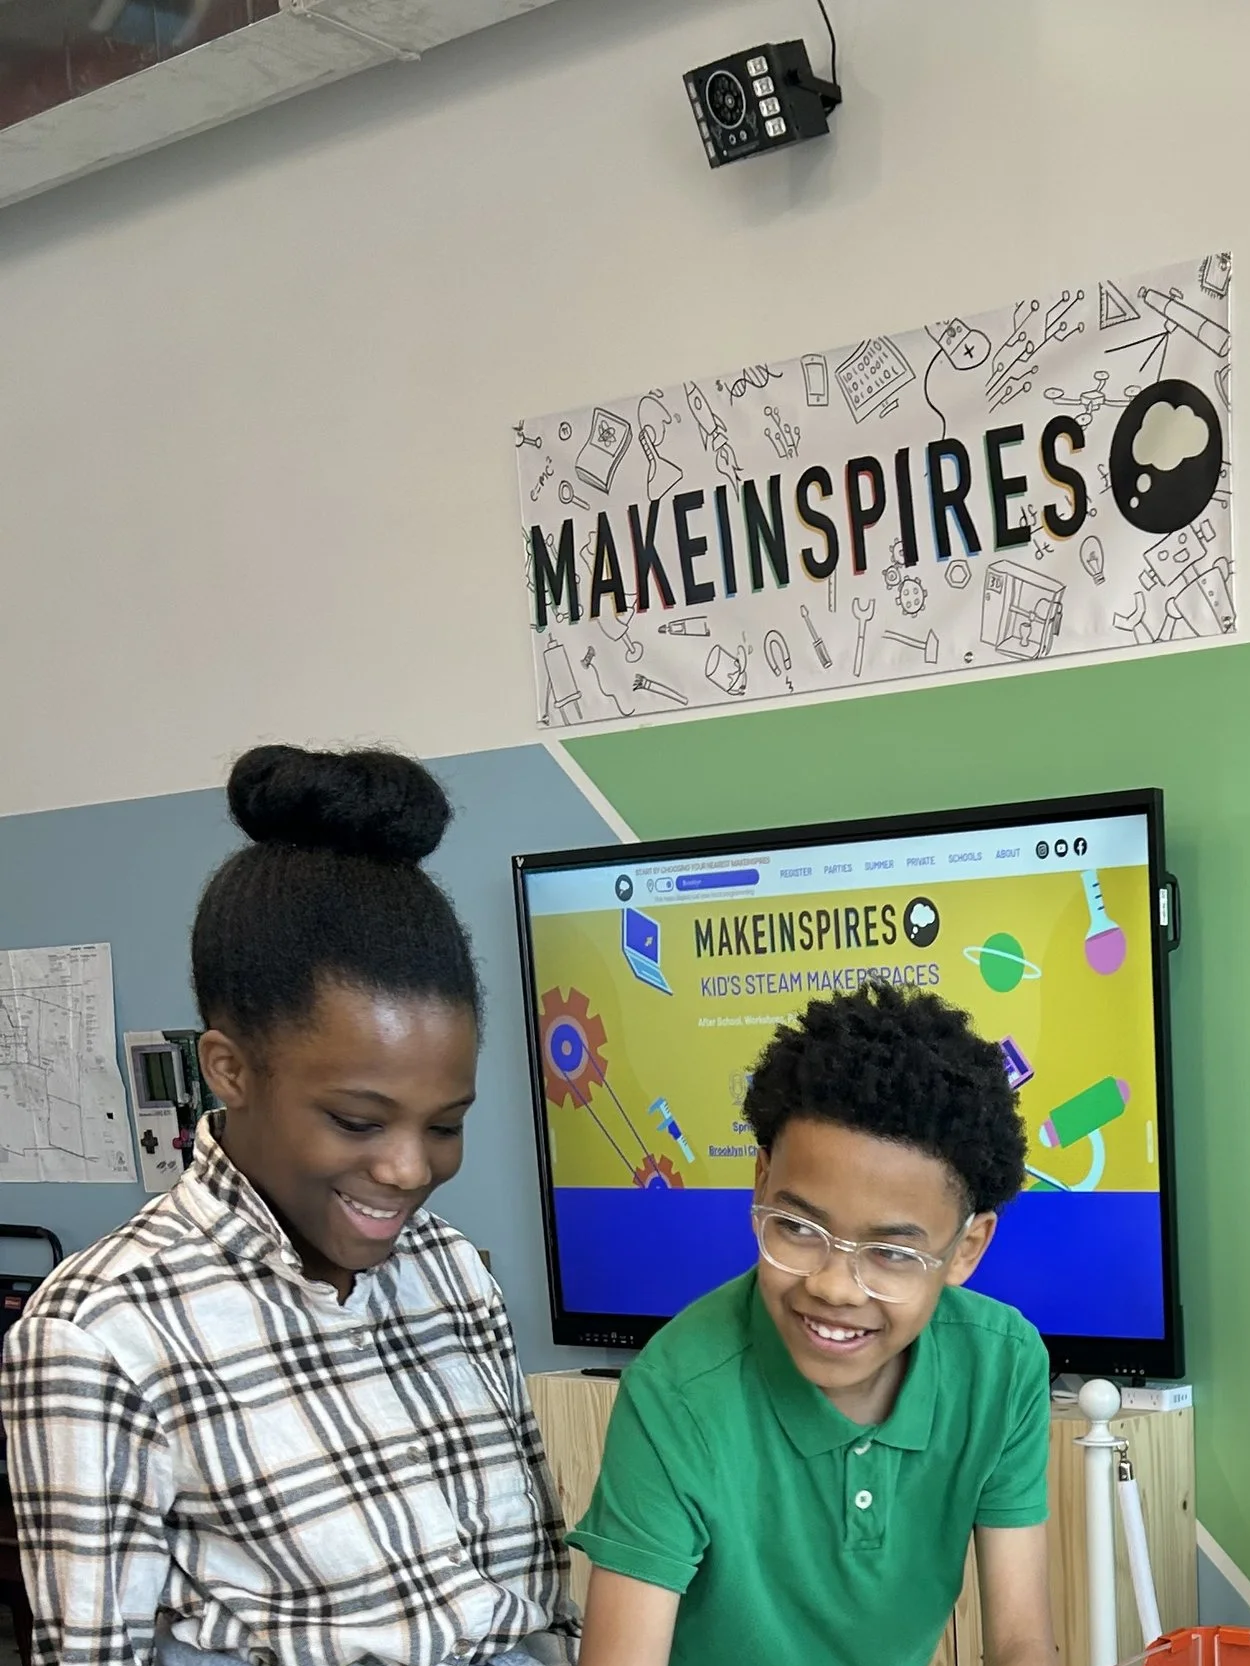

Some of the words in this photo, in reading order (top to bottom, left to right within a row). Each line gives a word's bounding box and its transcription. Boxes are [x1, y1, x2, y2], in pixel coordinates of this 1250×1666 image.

[530, 415, 1088, 627] MAKEINSPIRES
[948, 852, 982, 863] SCHOOLS
[995, 848, 1021, 859] ABOUT
[864, 859, 894, 871] SUMMER
[906, 856, 936, 867] PRIVATE
[780, 867, 812, 879] REGISTER
[824, 863, 853, 875] PARTIES
[694, 904, 897, 958] MAKEINSPIRES
[701, 976, 741, 997] KID'S
[745, 972, 801, 995] STEAM
